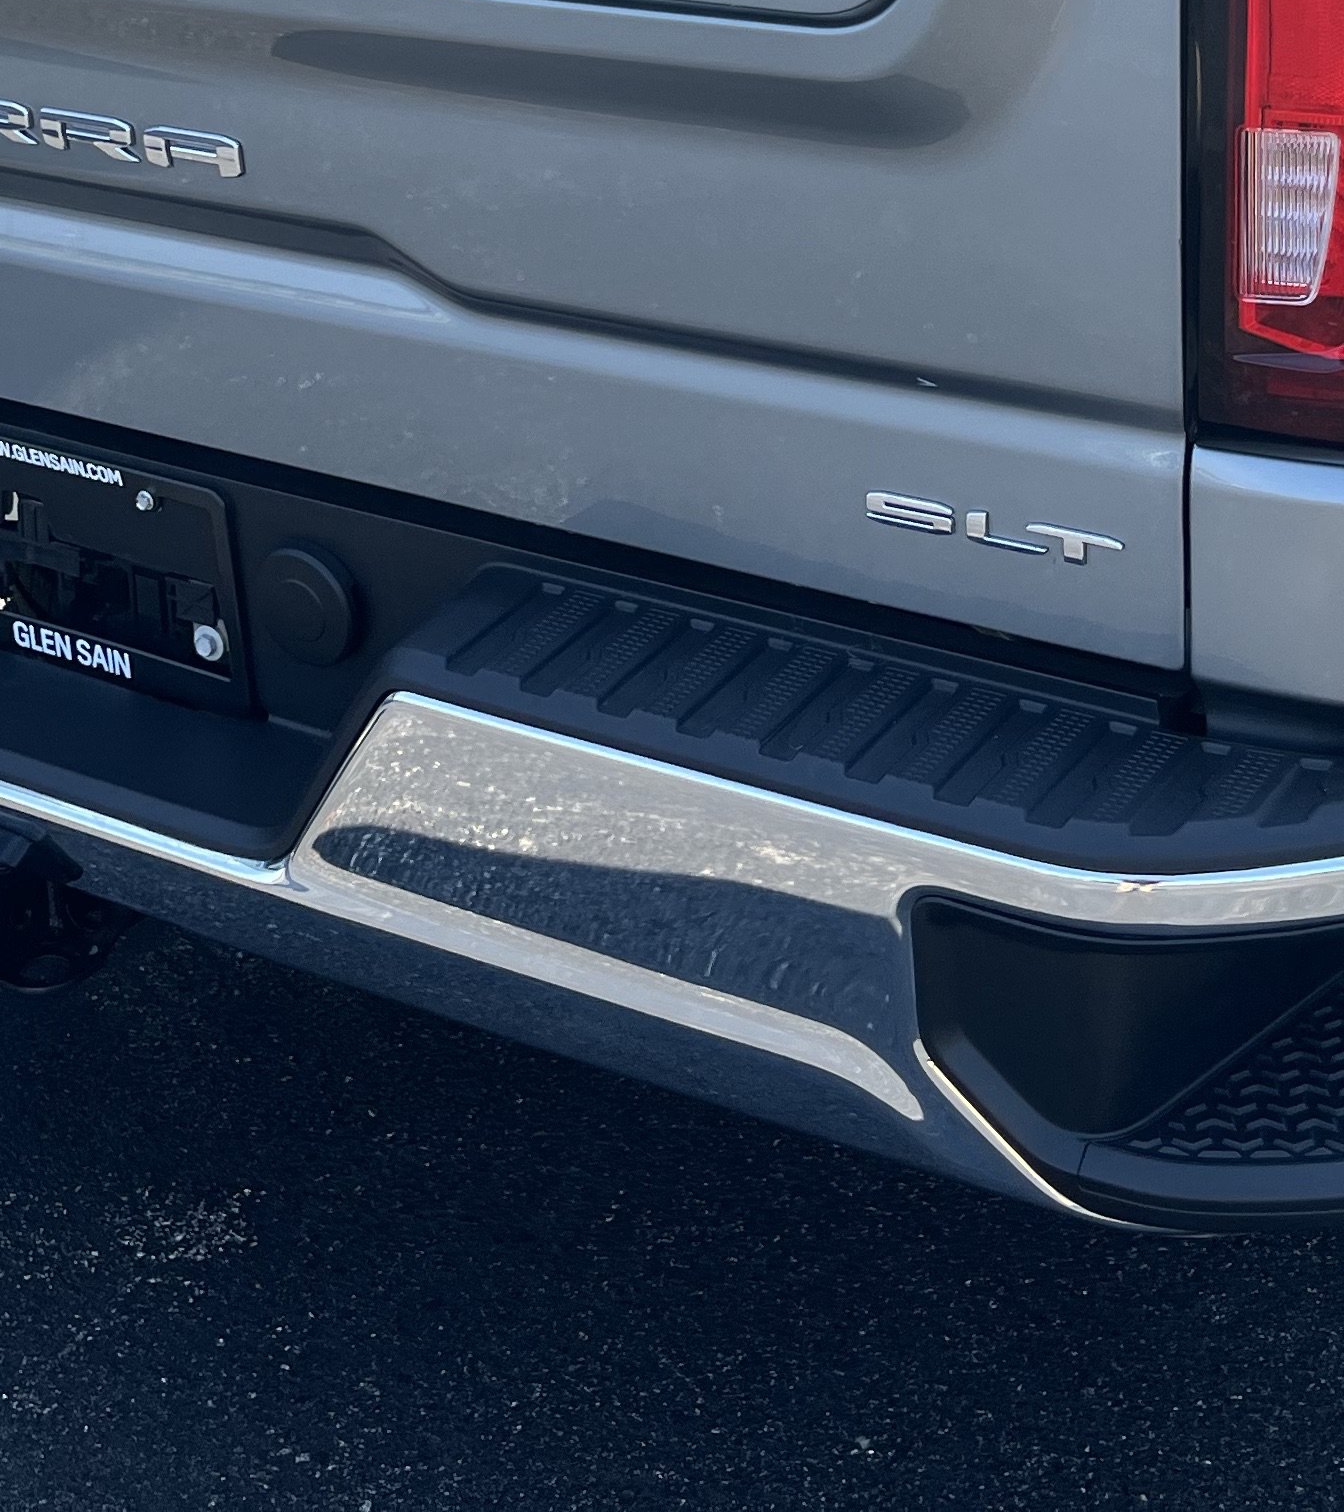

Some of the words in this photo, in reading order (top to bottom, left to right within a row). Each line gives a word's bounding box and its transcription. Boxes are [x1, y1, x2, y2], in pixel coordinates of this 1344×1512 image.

[866, 490, 1125, 565] SLT
[12, 620, 73, 661] GLEN
[76, 639, 132, 678] SAIN
